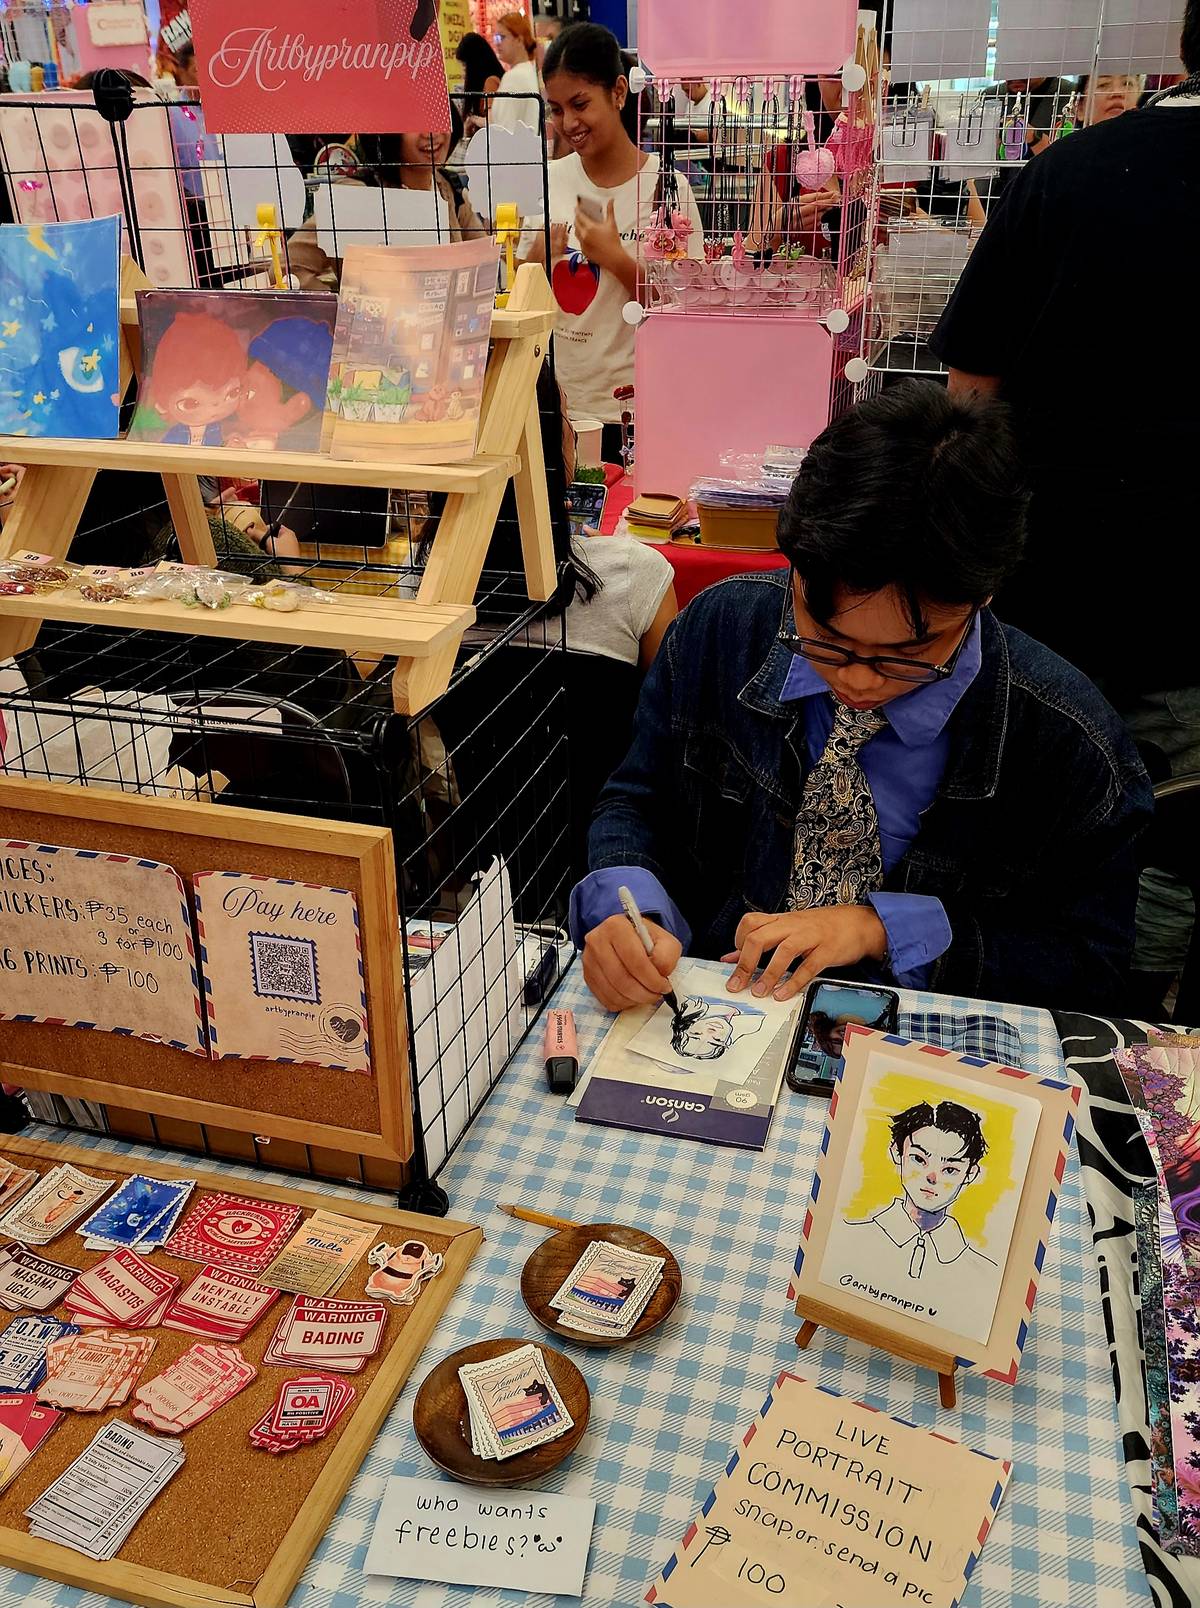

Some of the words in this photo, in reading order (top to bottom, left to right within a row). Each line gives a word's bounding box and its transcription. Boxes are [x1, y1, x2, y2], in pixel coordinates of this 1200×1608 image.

[208, 25, 436, 93] Artbypranpip
[222, 886, 285, 923] Pay
[290, 901, 338, 926] here
[128, 927, 140, 935] or
[137, 915, 173, 935] each
[97, 931, 108, 945] 3
[116, 935, 137, 951] for
[306, 1237, 344, 1253] Multo
[10, 1267, 58, 1291] MASAMA
[19, 1256, 75, 1281] WARNING
[119, 1254, 164, 1294] WARNING
[209, 1268, 272, 1294] WARNING
[5, 1281, 41, 1300] UGALI
[94, 1266, 145, 1310] MAGASTOS
[199, 1281, 262, 1306] MENTALLY
[191, 1292, 252, 1317] UNSTABLE
[304, 1310, 376, 1323] WARNING
[302, 1330, 364, 1345] BADING
[291, 1395, 320, 1408] OA
[105, 1430, 134, 1450] BADING
[836, 1419, 890, 1456] LIVE
[776, 1428, 922, 1504] PORTRAIT
[417, 1495, 459, 1512] who
[479, 1503, 548, 1520] wants
[748, 1462, 933, 1562] COMMISSION
[395, 1519, 529, 1558] freebies?
[738, 1557, 786, 1594] 100
[824, 1542, 879, 1575] send
[884, 1571, 899, 1586] a
[903, 1582, 934, 1604] pic
